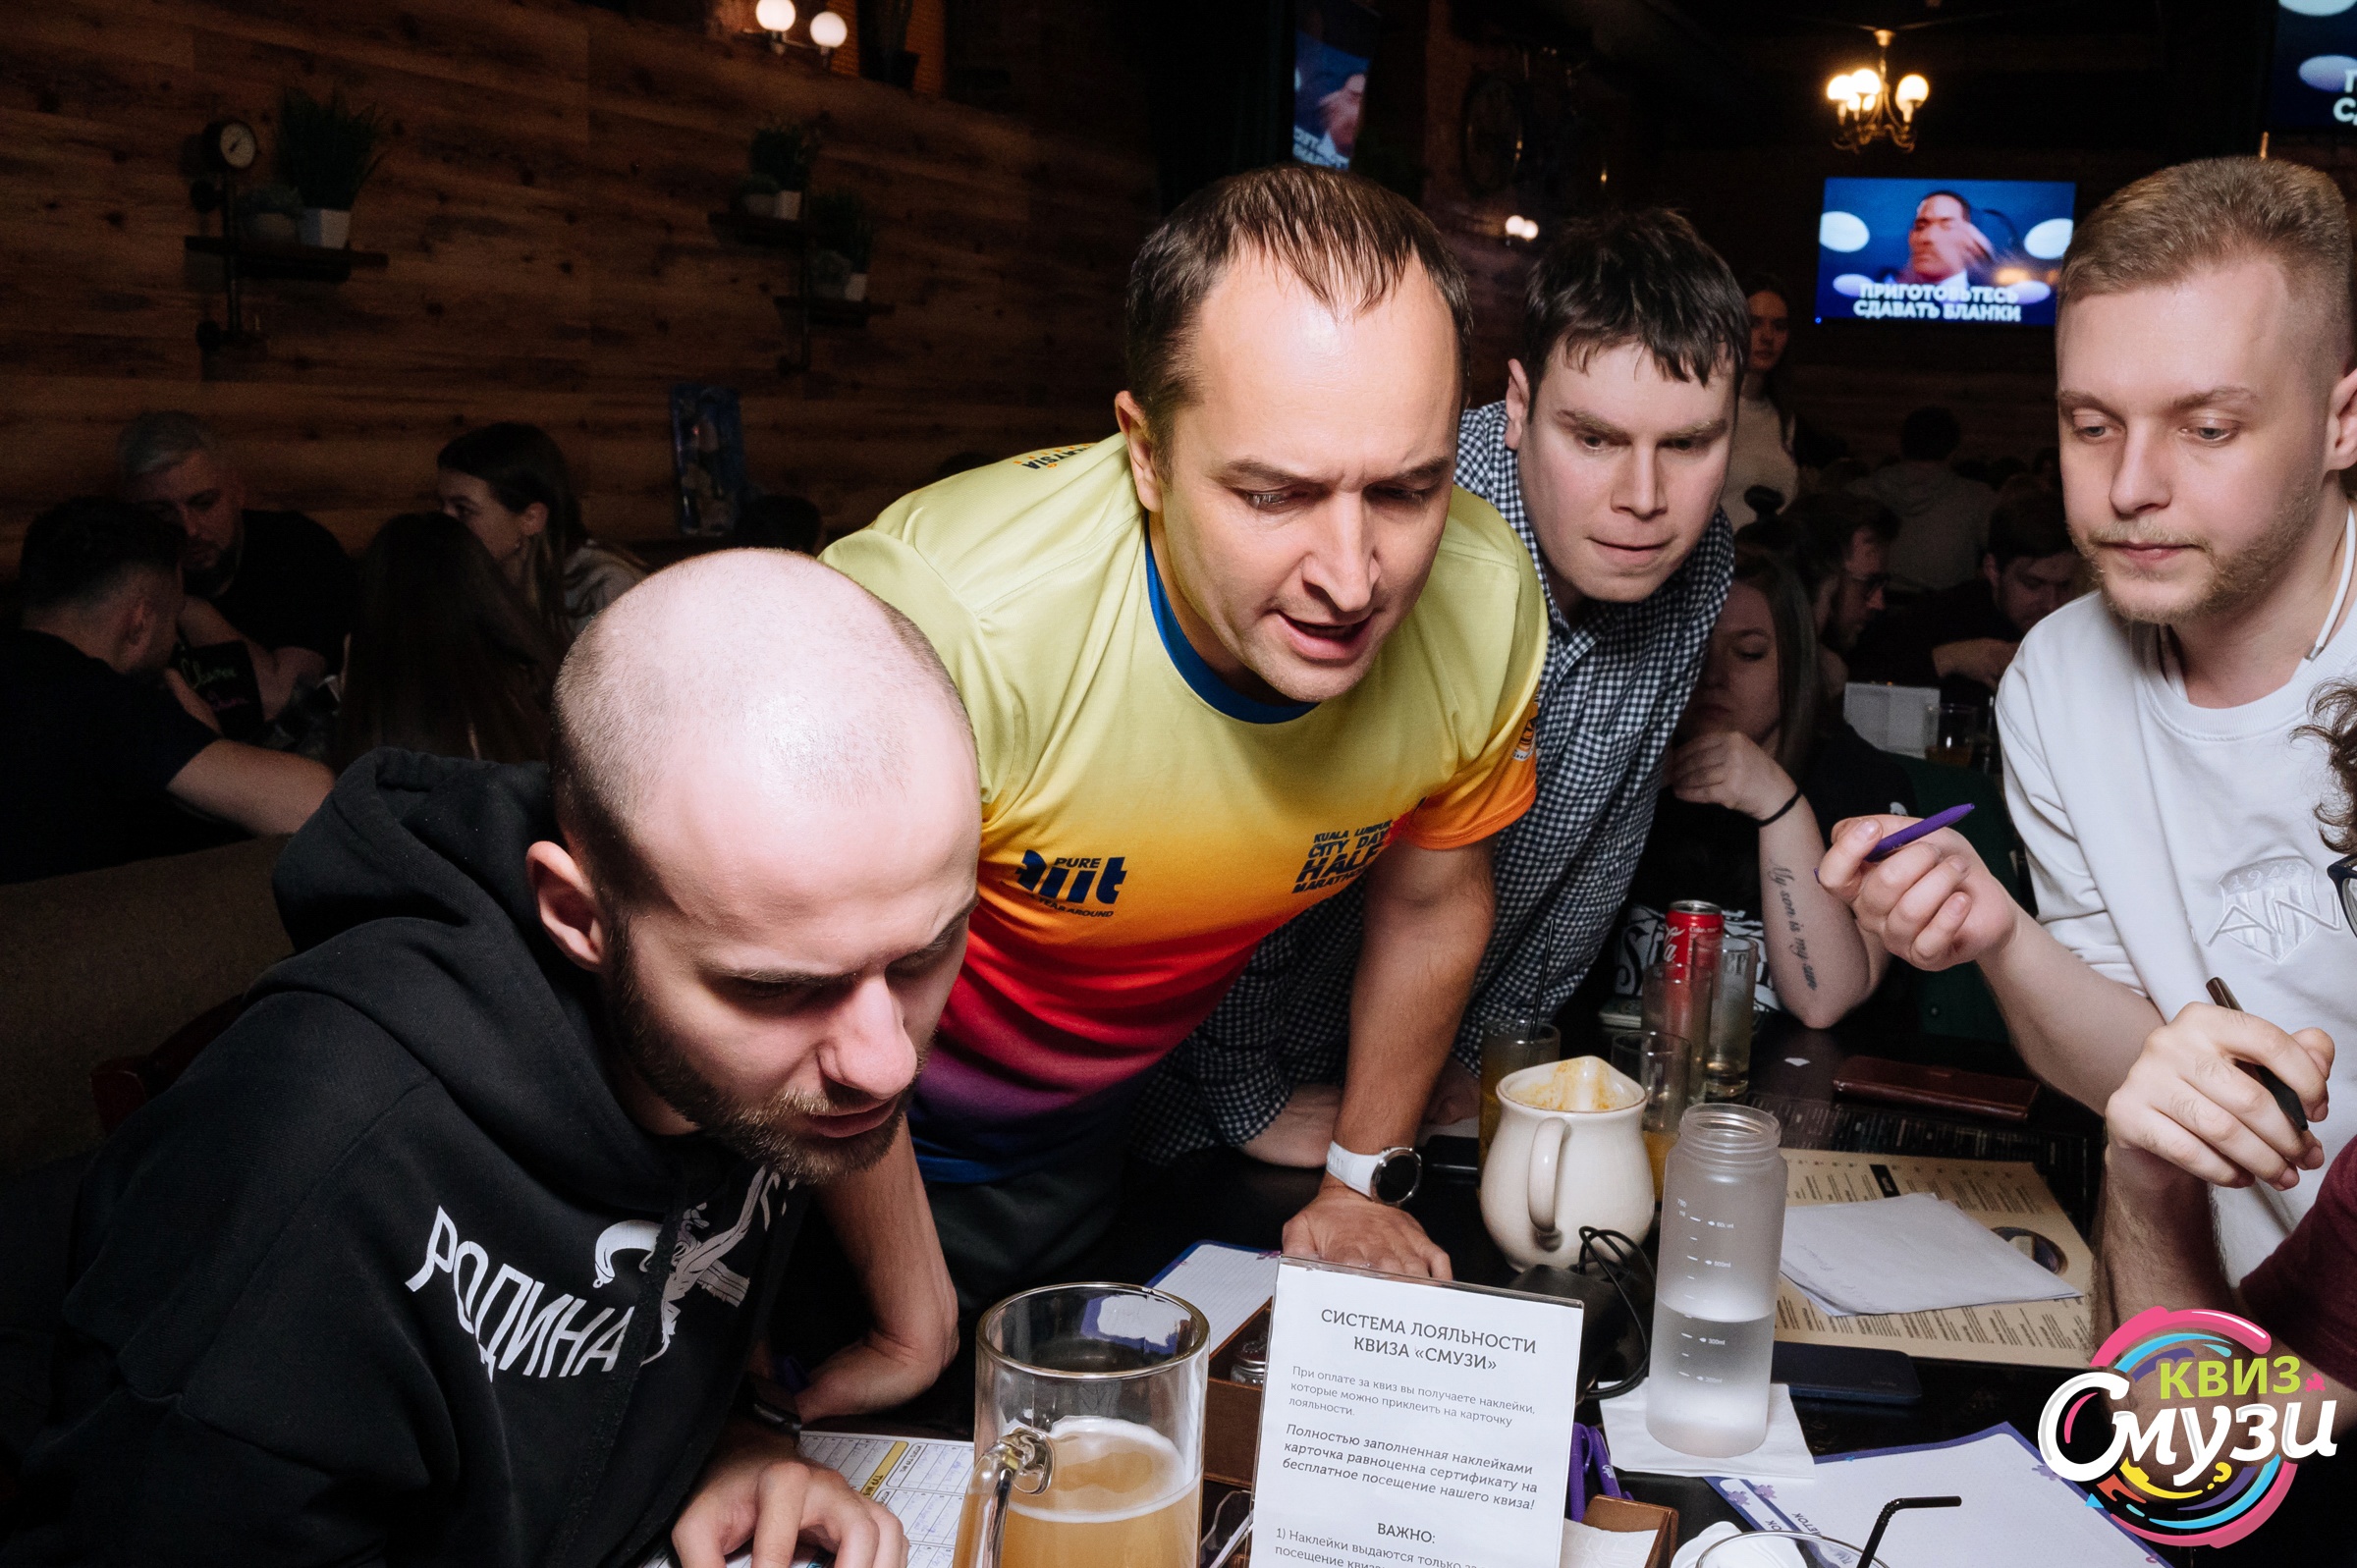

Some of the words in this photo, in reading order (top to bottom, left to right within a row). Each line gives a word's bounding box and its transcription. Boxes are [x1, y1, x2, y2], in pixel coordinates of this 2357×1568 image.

[1853, 299, 1940, 319] СДАВАТЬ
[1943, 304, 2021, 322] БЛАНКИ
[1859, 283, 2019, 304] ПРИГОТОВЬТЕСЬ
[1308, 839, 1350, 859] CITY
[1355, 828, 1391, 849] DAY
[1314, 830, 1349, 843] KUALA
[1054, 857, 1101, 868] PURE
[1295, 841, 1384, 883] HALF
[1067, 908, 1114, 918] AROUND
[405, 1205, 635, 1382] РОДИНА
[1321, 1308, 1406, 1335] СИСТЕМА
[1410, 1322, 1537, 1354] ЛОЯЛЬНОСТИ
[1353, 1336, 1410, 1358] КВИЗА
[1414, 1347, 1498, 1371] «СМУЗИ»
[1288, 1397, 1355, 1416] лояльности.
[1290, 1382, 1338, 1398] которые
[1341, 1391, 1380, 1405] можно
[1382, 1397, 1441, 1415] приклеить
[1444, 1407, 1457, 1417] на
[1460, 1410, 1513, 1428] карточку
[1292, 1365, 1315, 1379] При
[1317, 1372, 1356, 1385] оплате
[1358, 1379, 1370, 1387] за
[1372, 1380, 1398, 1392] квиз
[1399, 1385, 1415, 1395] вы
[1417, 1387, 1476, 1405] получаете
[1479, 1397, 1535, 1415] наклейки,
[1286, 1424, 1360, 1446] Полностью
[1363, 1438, 1449, 1461] заполненная
[1452, 1453, 1533, 1475] наклейками
[1282, 1457, 1359, 1481] бесплатное
[1361, 1473, 1437, 1493] посещение
[1439, 1486, 1490, 1503] нашего
[1492, 1495, 1535, 1510] квиза!
[1284, 1443, 1343, 1461] карточка
[1345, 1453, 1426, 1475] равноценна
[1429, 1467, 1519, 1491] сертификату
[1521, 1482, 1538, 1493] на
[1276, 1528, 1287, 1541] 1)
[1288, 1529, 1348, 1551] Наклейки
[1351, 1543, 1414, 1563] выдаются
[1417, 1555, 1461, 1568] только
[1377, 1522, 1436, 1544] ВАЖНО:
[1275, 1546, 1344, 1568] посещение
